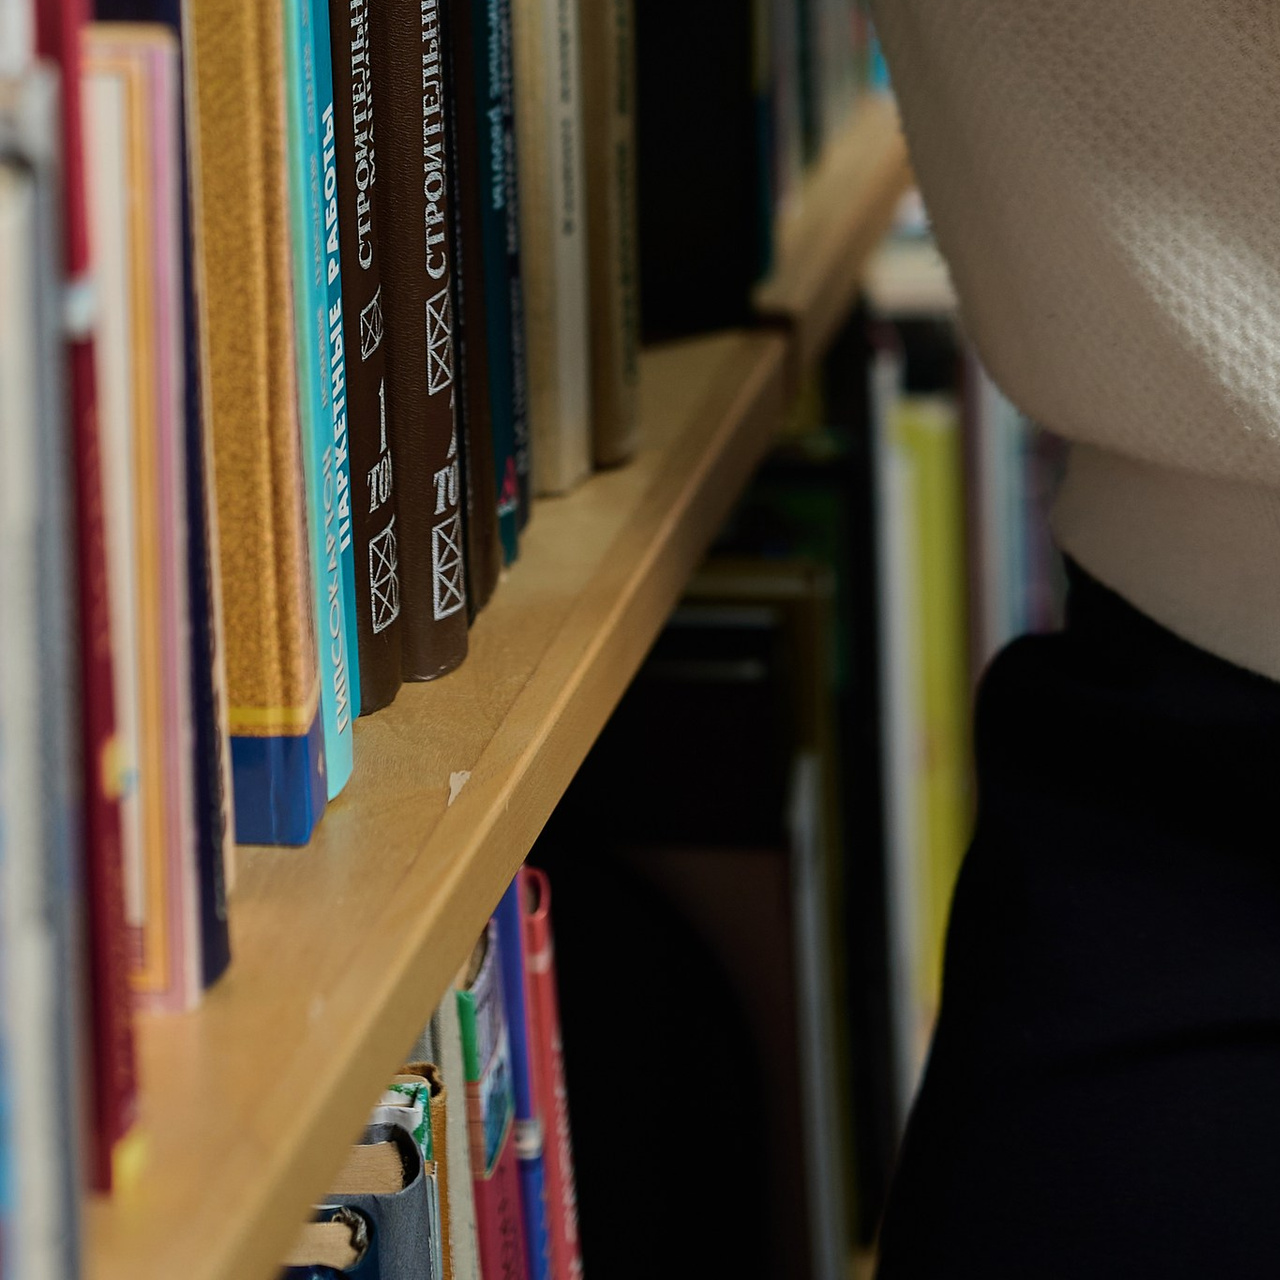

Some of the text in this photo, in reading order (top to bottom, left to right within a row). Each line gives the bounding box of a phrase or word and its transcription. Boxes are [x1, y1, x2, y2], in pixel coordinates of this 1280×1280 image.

[322, 102, 351, 554] ПАРКЕТНЫЕ РАБОТЫ
[322, 445, 348, 735] ГИПСОКАРТОН
[433, 460, 459, 515] ТО
